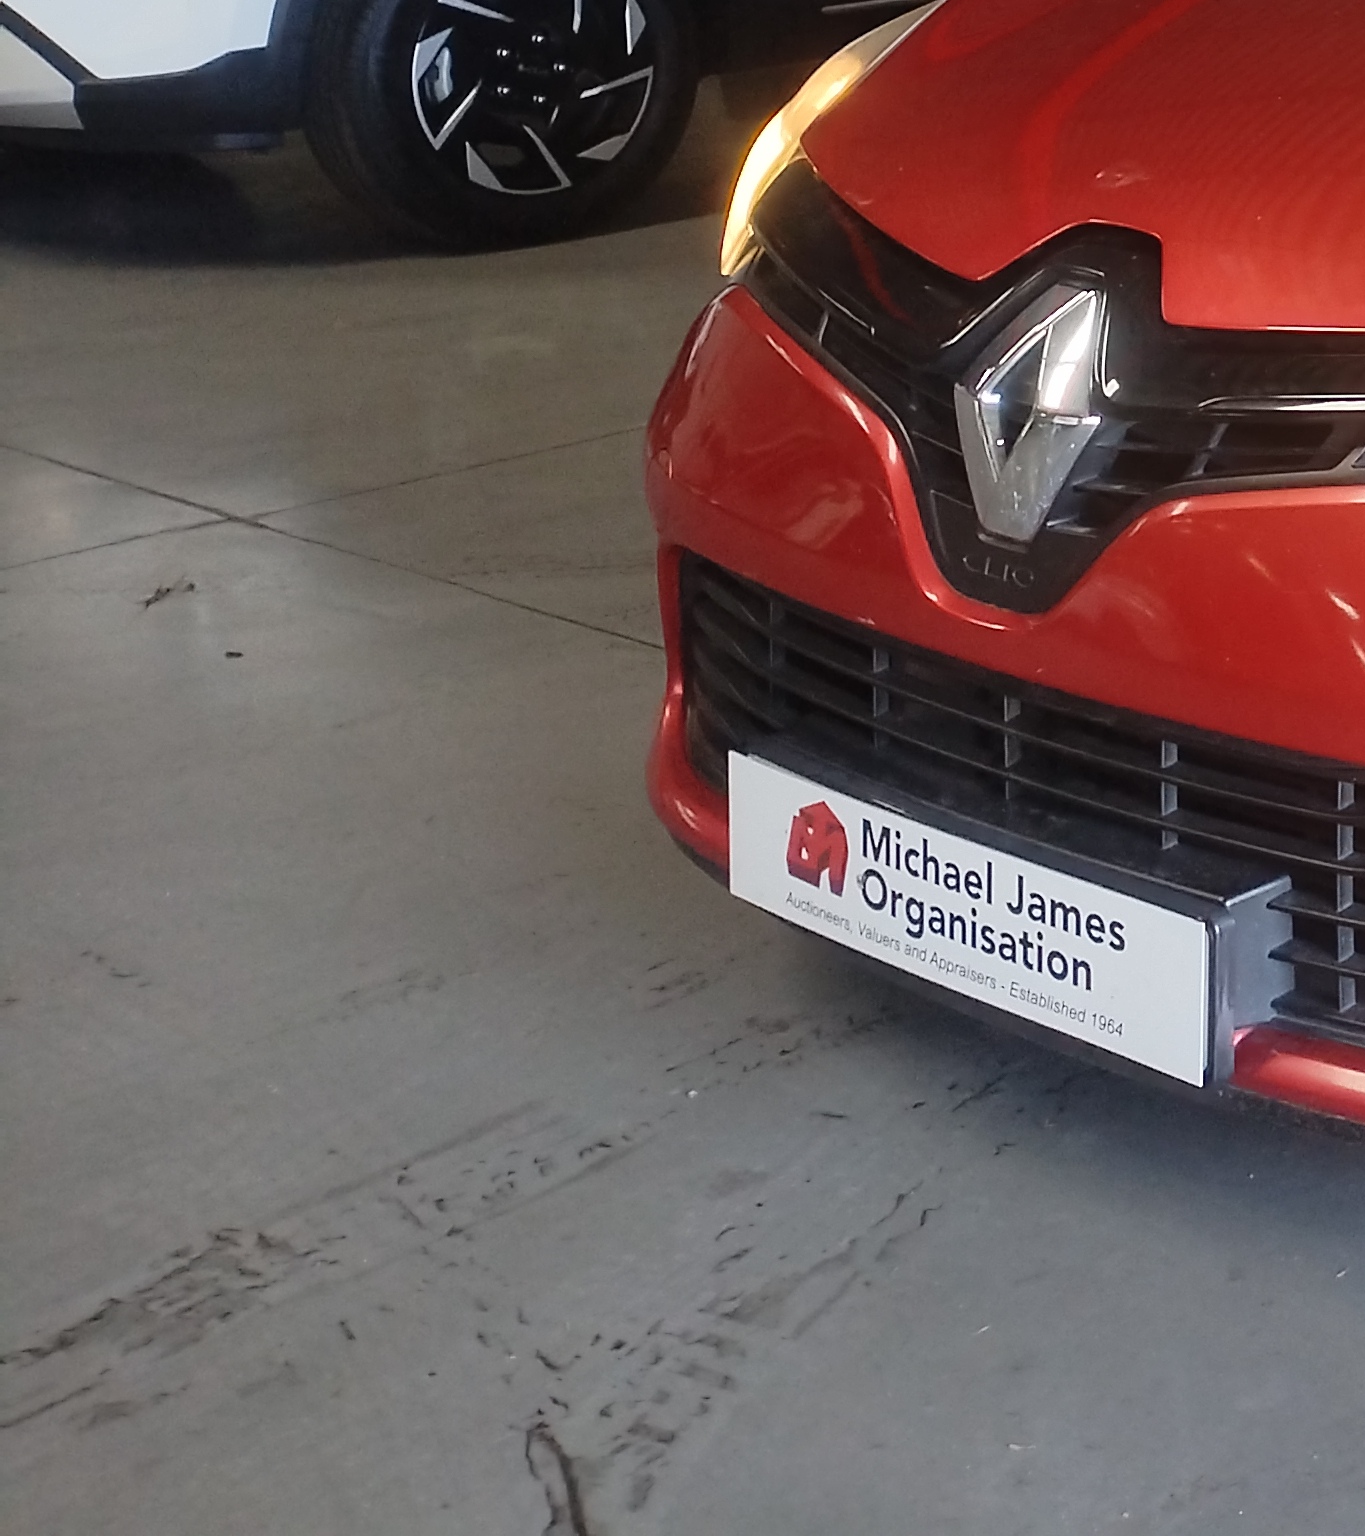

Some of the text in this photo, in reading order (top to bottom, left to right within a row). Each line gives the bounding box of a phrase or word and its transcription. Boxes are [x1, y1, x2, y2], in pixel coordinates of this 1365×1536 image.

[861, 868, 1092, 991] Organisation
[862, 818, 1126, 951] Michael James
[786, 892, 853, 934] Auctioneers,
[858, 921, 900, 952] Valuers
[904, 944, 927, 962] and
[929, 952, 997, 990] Appraisers
[1010, 981, 1085, 1023] Established
[1092, 1013, 1124, 1038] 1964
